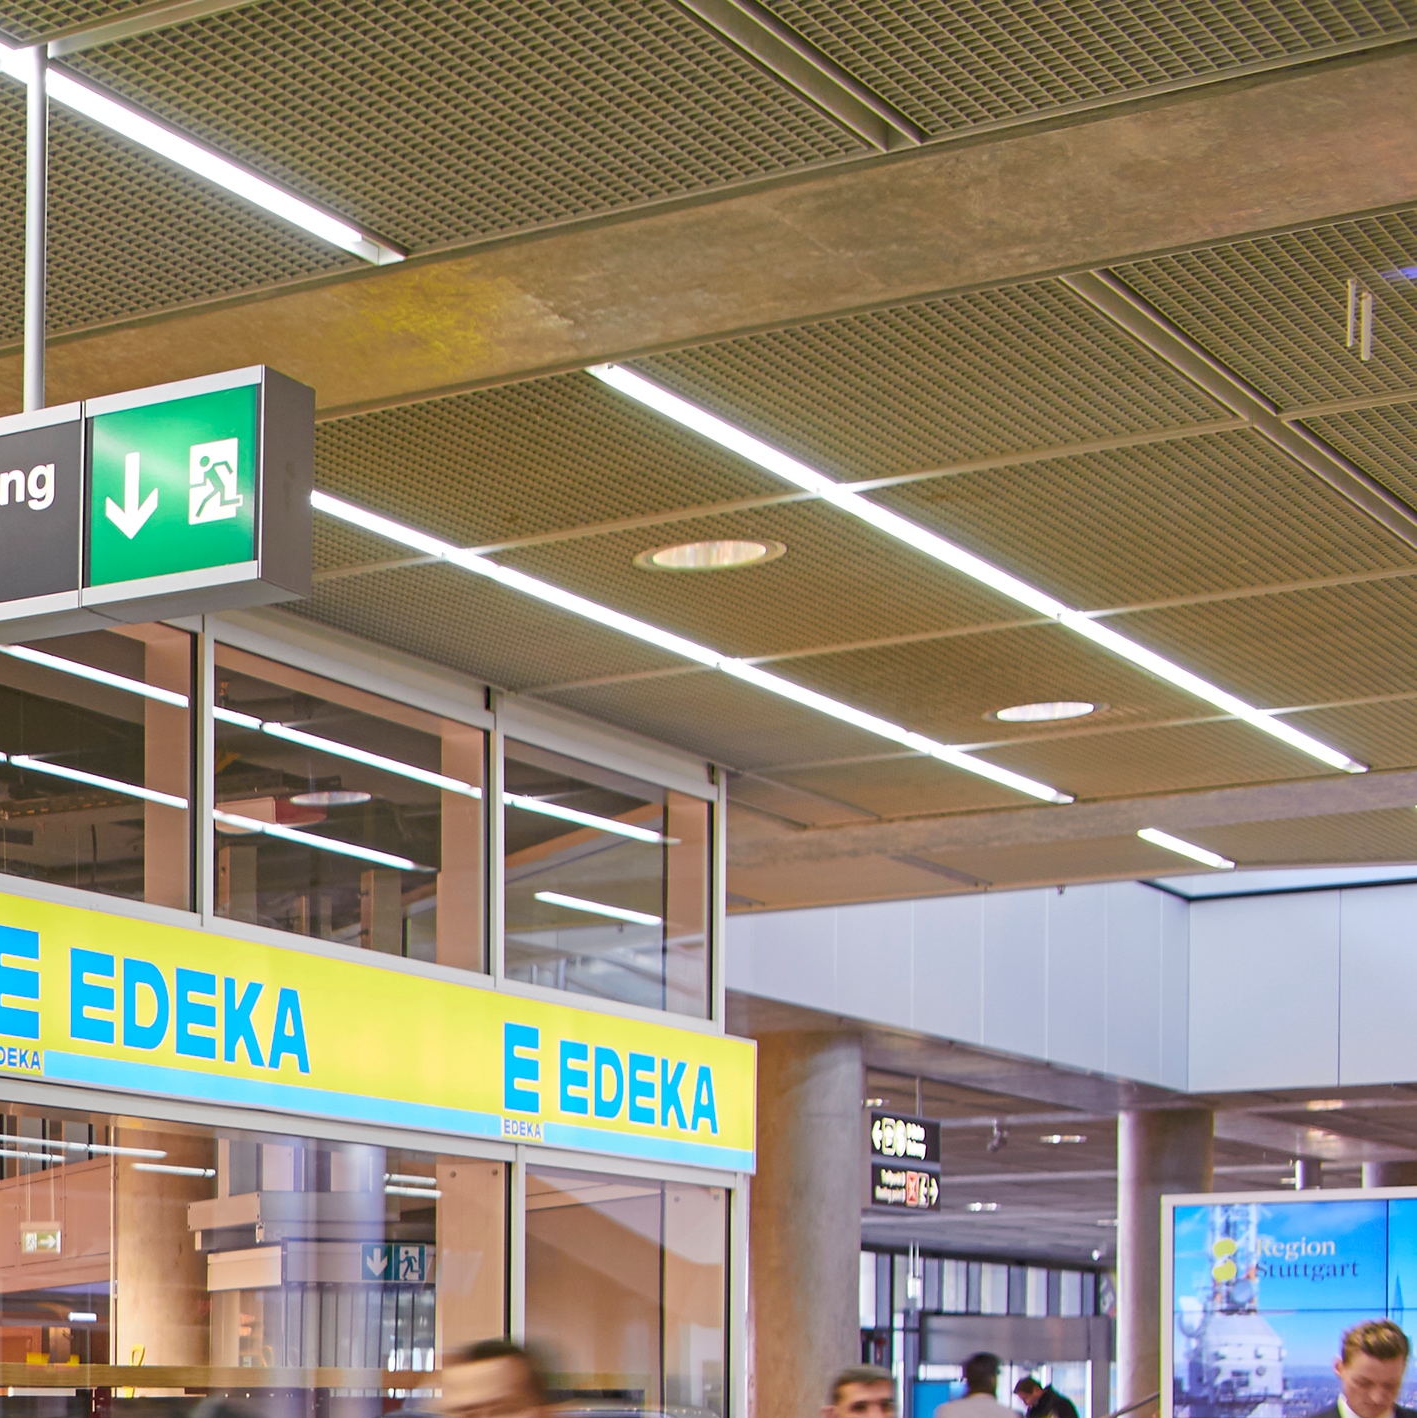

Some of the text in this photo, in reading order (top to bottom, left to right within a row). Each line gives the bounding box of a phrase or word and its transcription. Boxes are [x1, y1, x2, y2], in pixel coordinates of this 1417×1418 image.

[70, 946, 311, 1075] EDEKA
[503, 1022, 540, 1114] E
[559, 1039, 719, 1135] EDEKA
[504, 1118, 542, 1138] EDEKA
[1255, 1259, 1359, 1282] Stuttgart
[1256, 1236, 1336, 1262] Region
